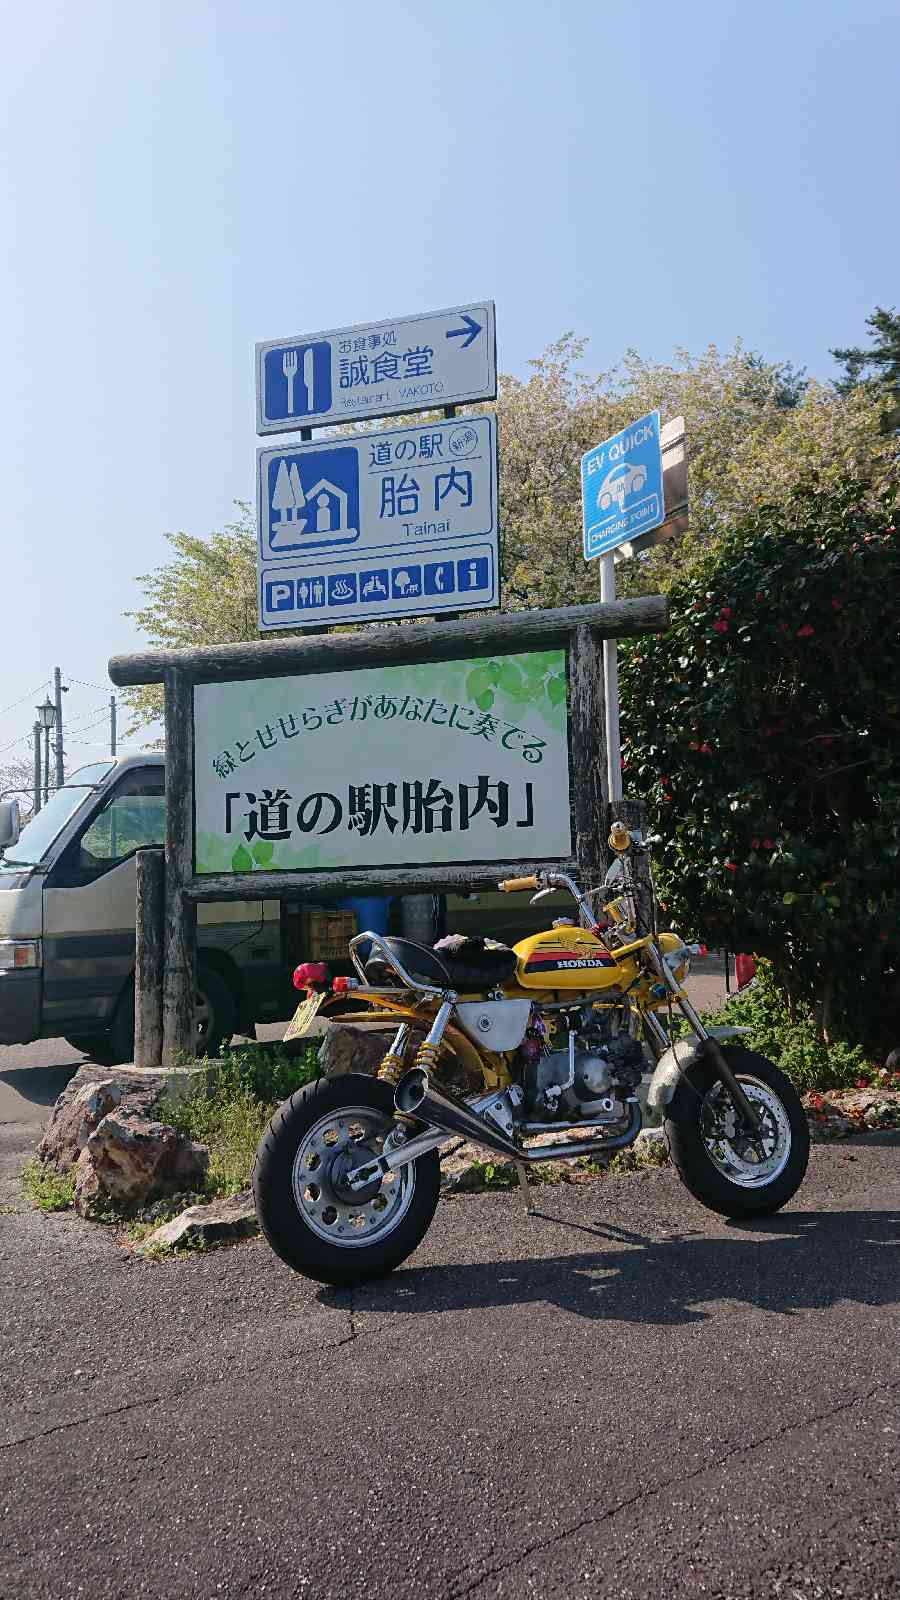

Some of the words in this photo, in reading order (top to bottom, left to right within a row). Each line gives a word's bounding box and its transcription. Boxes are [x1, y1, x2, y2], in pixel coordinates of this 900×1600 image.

[339, 330, 398, 354] お食事処
[339, 345, 434, 389] 誠食堂
[368, 432, 444, 468] 道の駅
[587, 455, 605, 475] EV
[608, 425, 655, 461] QUICK
[379, 465, 473, 519] 胎内
[402, 519, 451, 538] Tainai
[212, 694, 547, 780] 緑とせせらぎがあなたに奏でる
[224, 775, 534, 842] 「道の駅胎内」
[557, 959, 604, 969] HONDA
